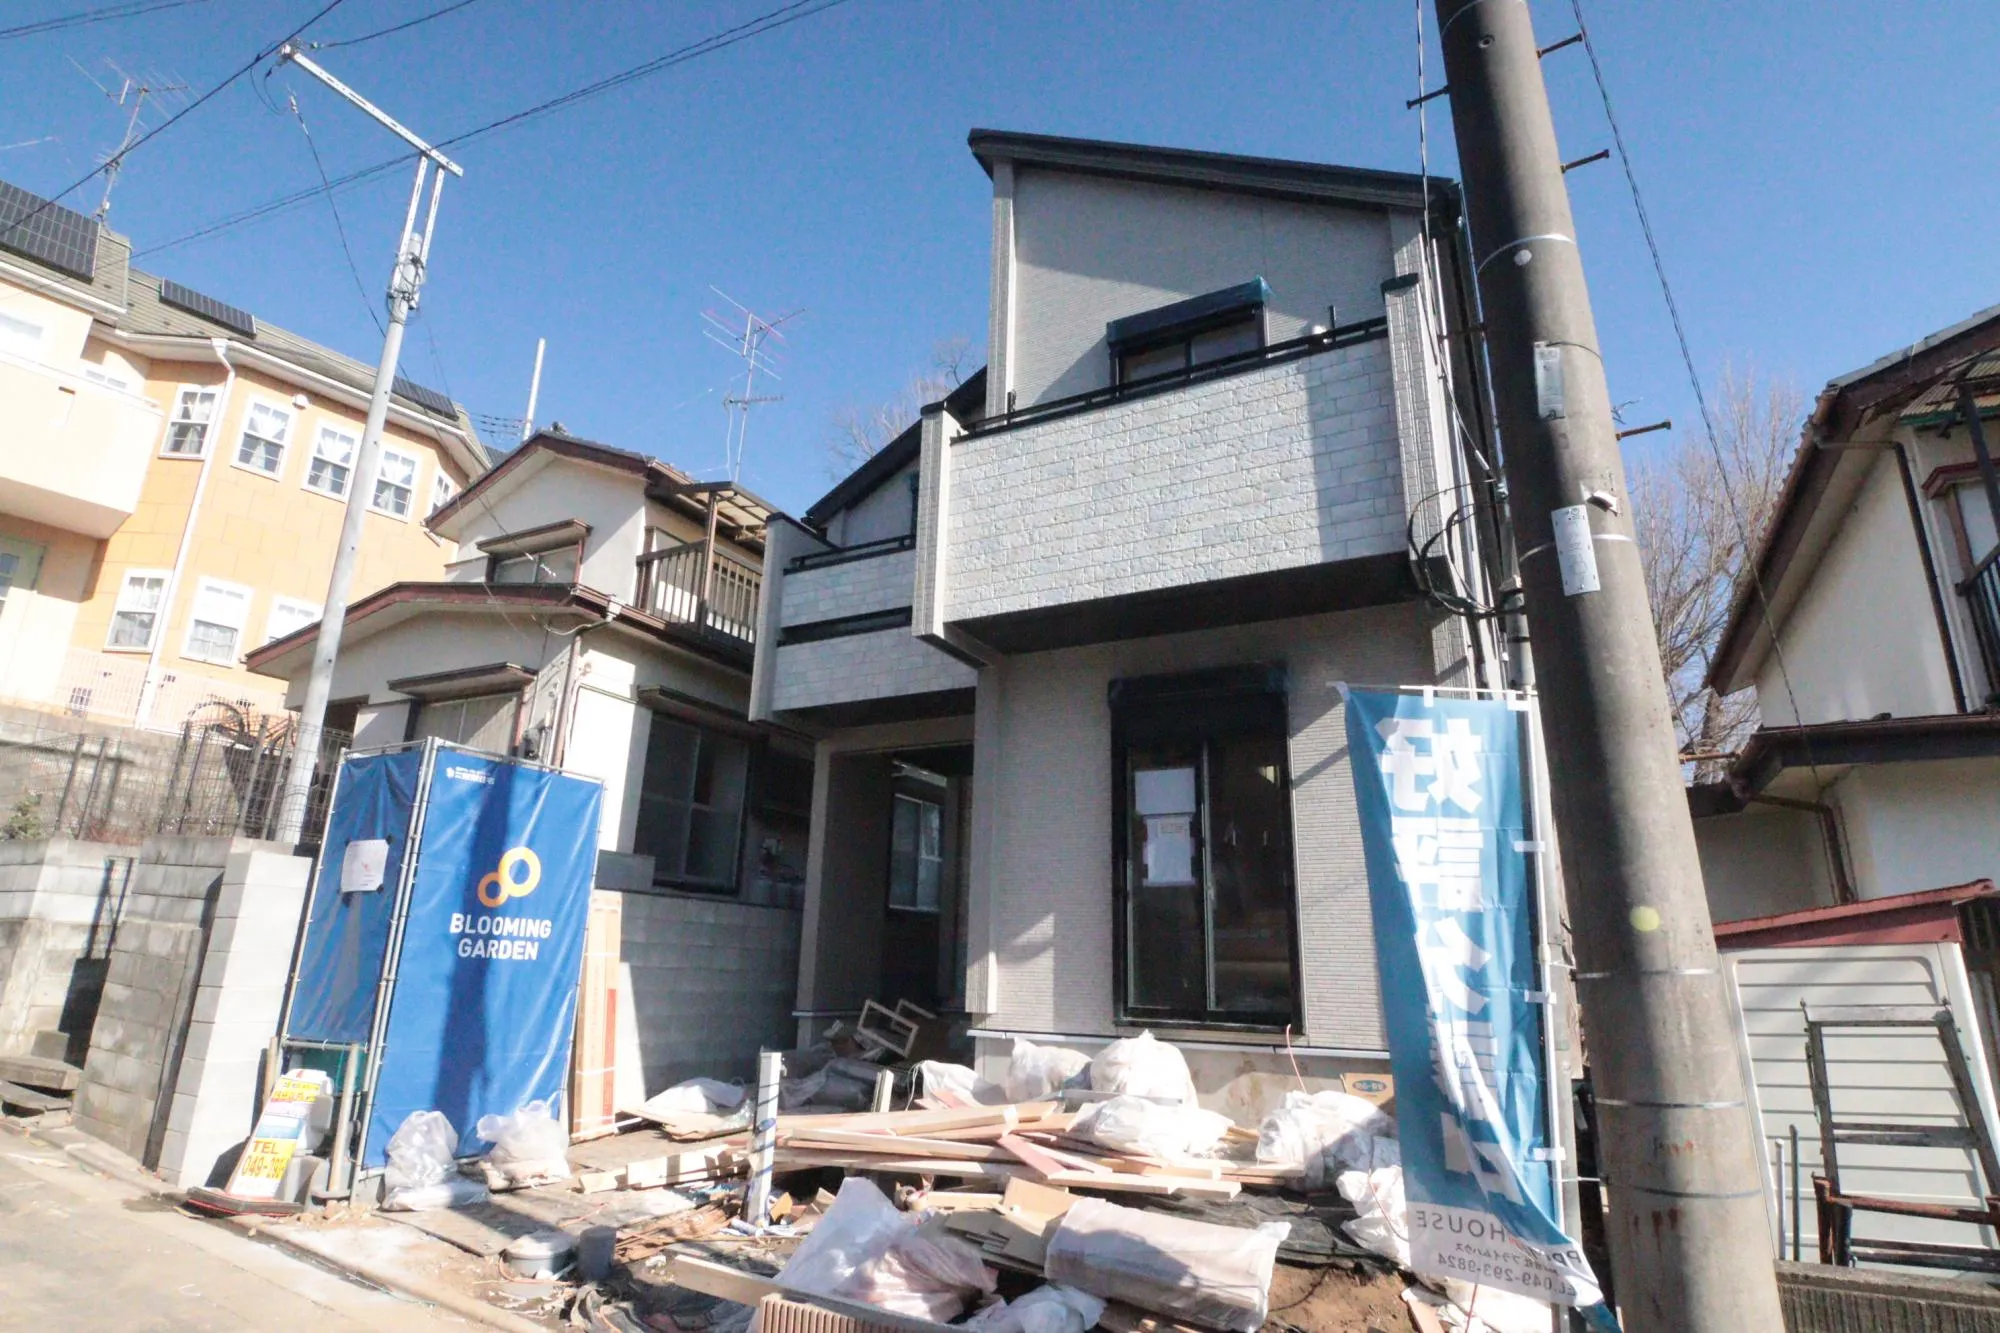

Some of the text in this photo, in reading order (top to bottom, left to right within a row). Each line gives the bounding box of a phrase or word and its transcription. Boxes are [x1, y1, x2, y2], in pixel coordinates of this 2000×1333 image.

[449, 913, 552, 938] BLOOMING
[458, 938, 539, 960] GARDEN
[252, 1140, 279, 1154] TEL
